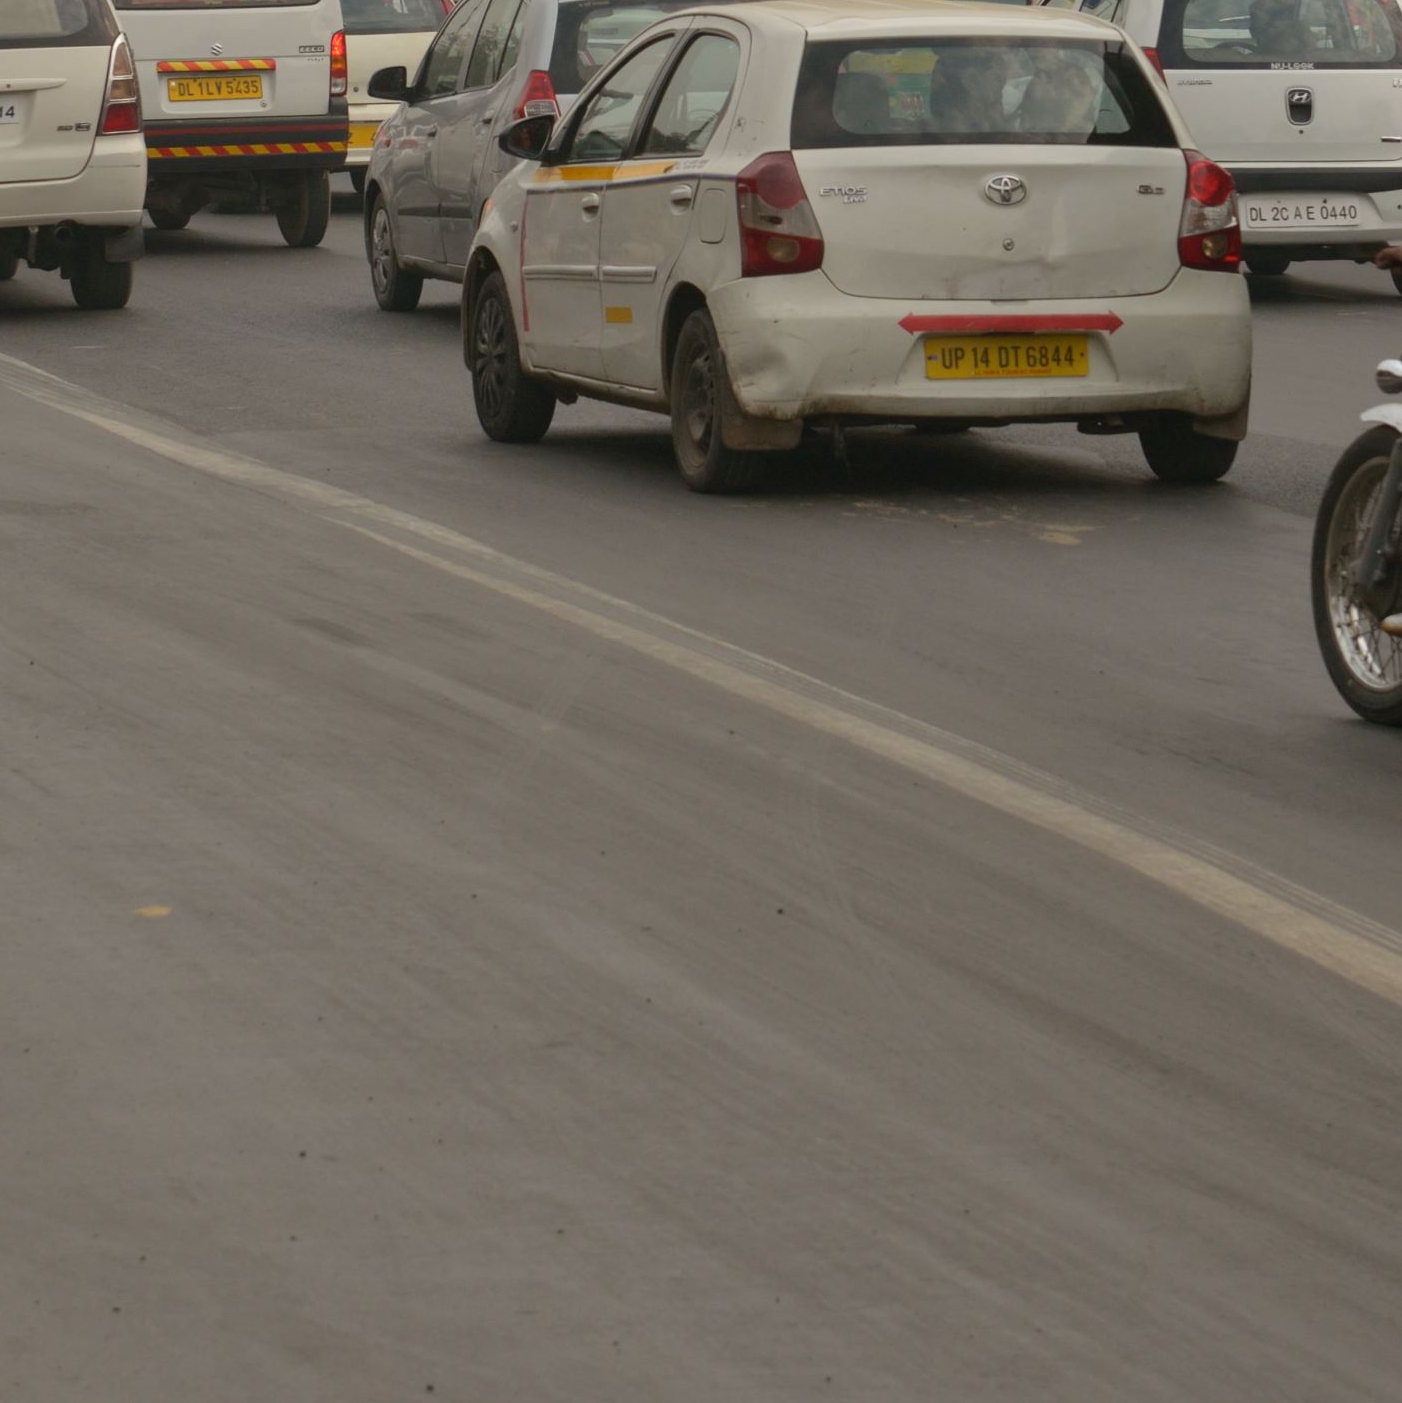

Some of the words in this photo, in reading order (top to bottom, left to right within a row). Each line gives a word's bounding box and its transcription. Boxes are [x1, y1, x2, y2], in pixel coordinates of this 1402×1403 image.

[178, 82, 194, 96] DL
[226, 80, 259, 95] 5435
[819, 186, 868, 197] ETIOS
[1249, 207, 1267, 222] DL
[1271, 206, 1289, 222] 2C
[1320, 205, 1358, 220] 0440
[941, 347, 965, 370] UP
[971, 347, 990, 369] 14
[998, 346, 1021, 368] DT
[1026, 344, 1074, 368] 6844
